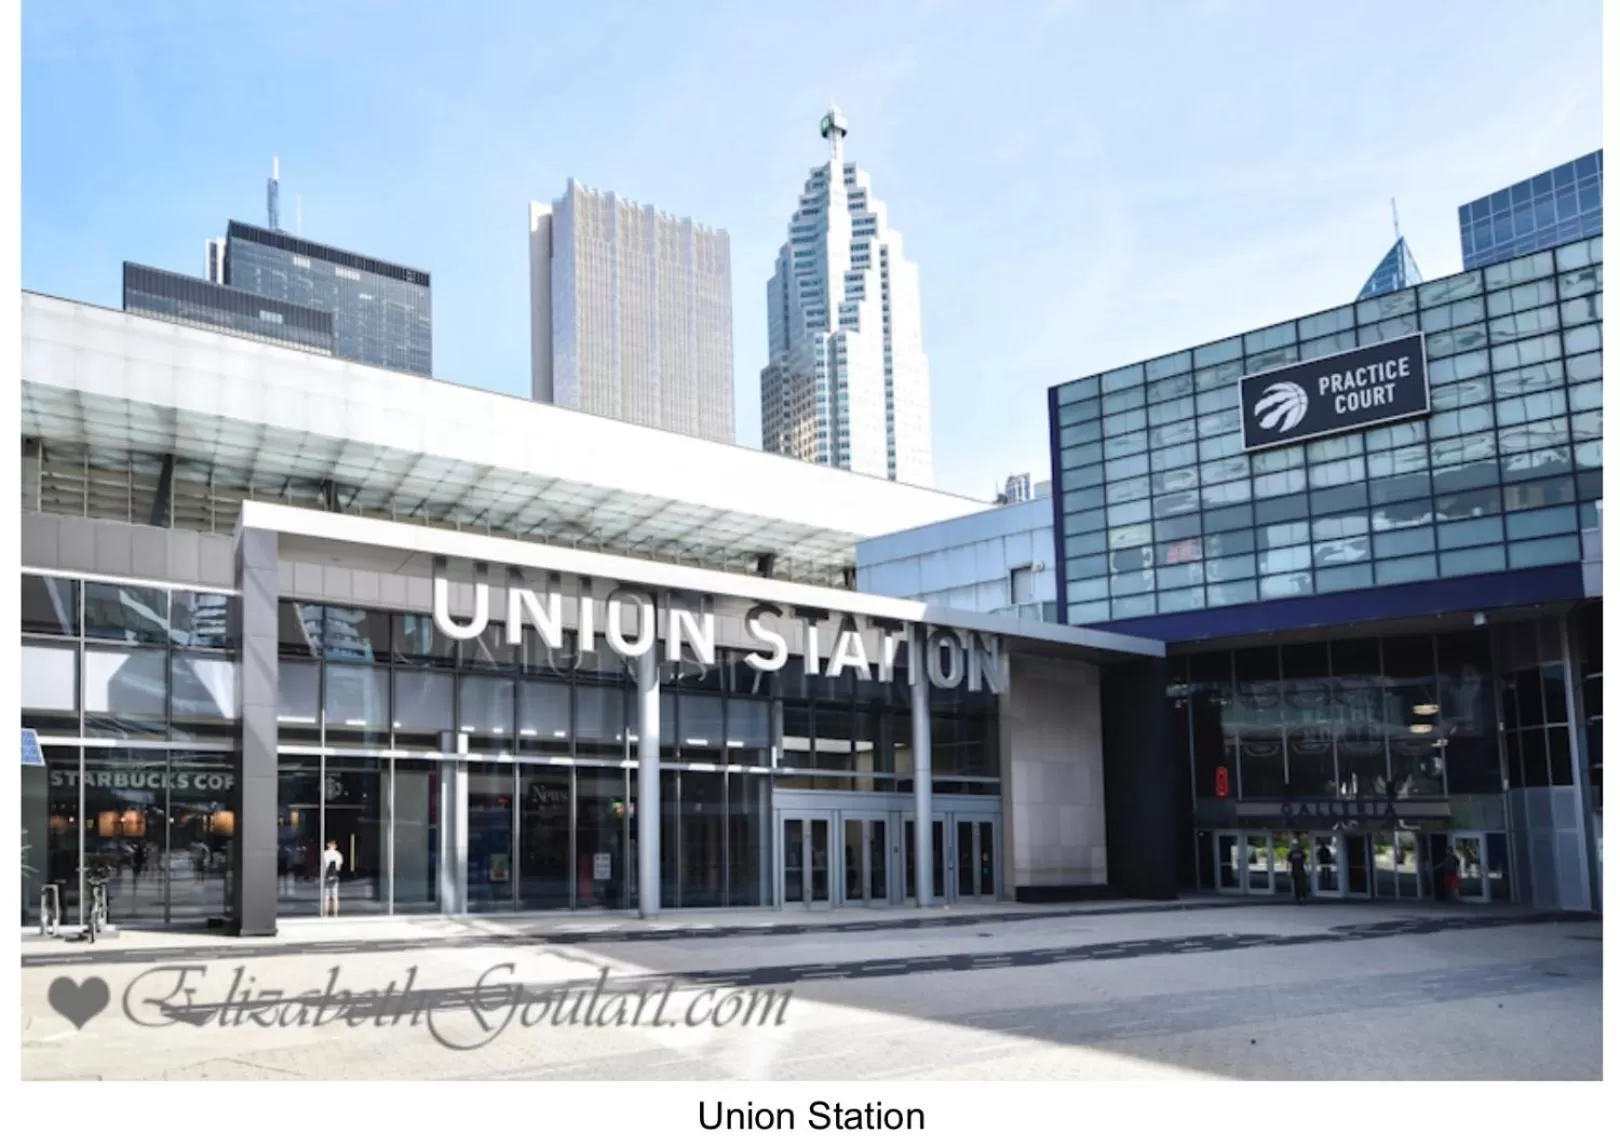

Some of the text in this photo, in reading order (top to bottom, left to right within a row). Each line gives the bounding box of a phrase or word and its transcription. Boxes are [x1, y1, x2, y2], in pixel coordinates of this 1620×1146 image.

[1318, 356, 1410, 396] PRACTICE
[1334, 382, 1396, 414] COURT
[432, 556, 1009, 695] UNION STATION
[51, 771, 189, 789] STARBUCKS
